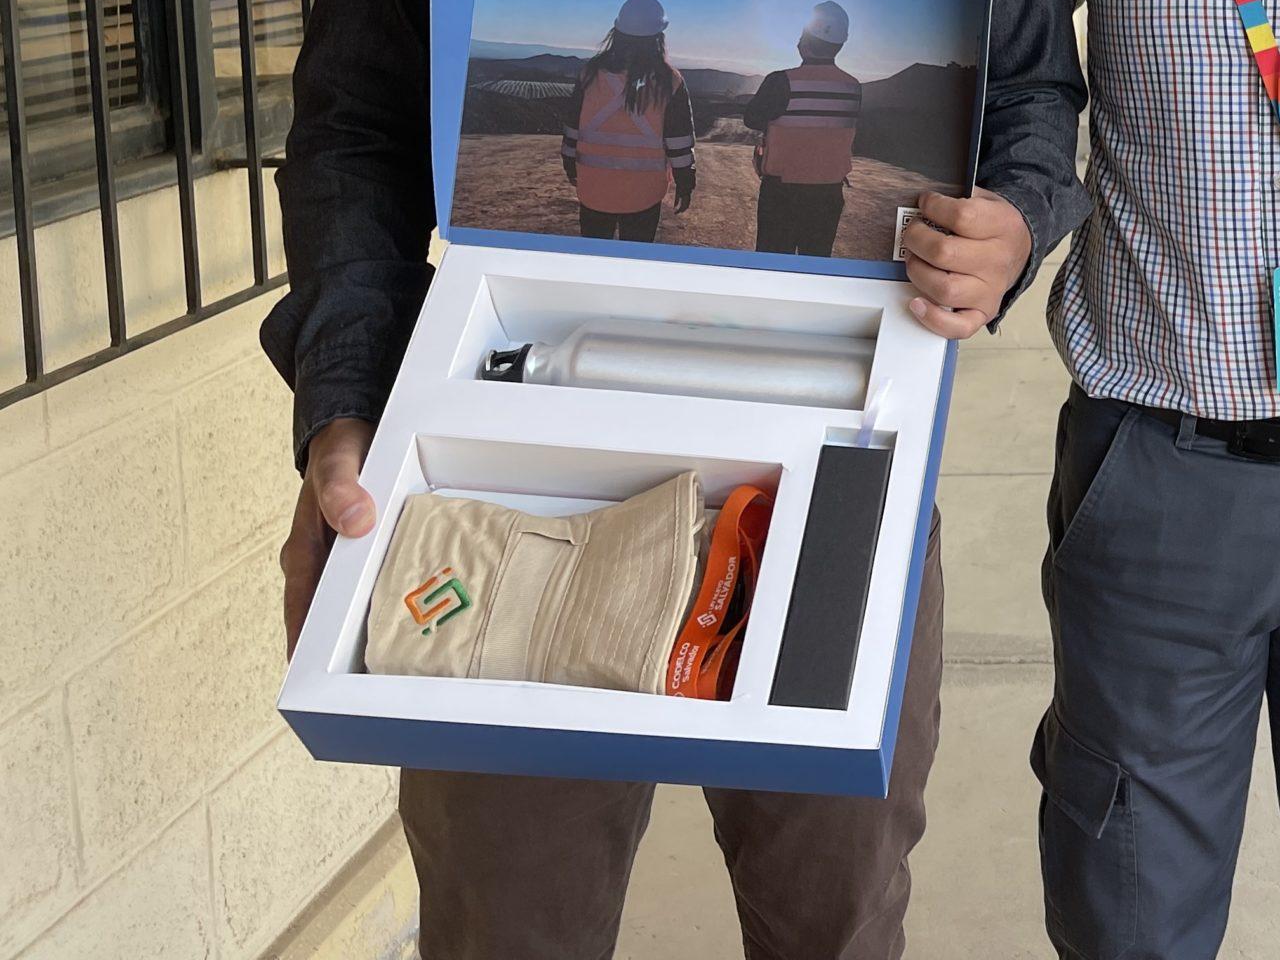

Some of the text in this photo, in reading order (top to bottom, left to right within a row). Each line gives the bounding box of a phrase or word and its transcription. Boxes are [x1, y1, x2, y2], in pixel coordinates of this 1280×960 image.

[714, 556, 736, 611] SALVADOR
[672, 642, 690, 690] CODELCO
[683, 645, 699, 683] Salvador
